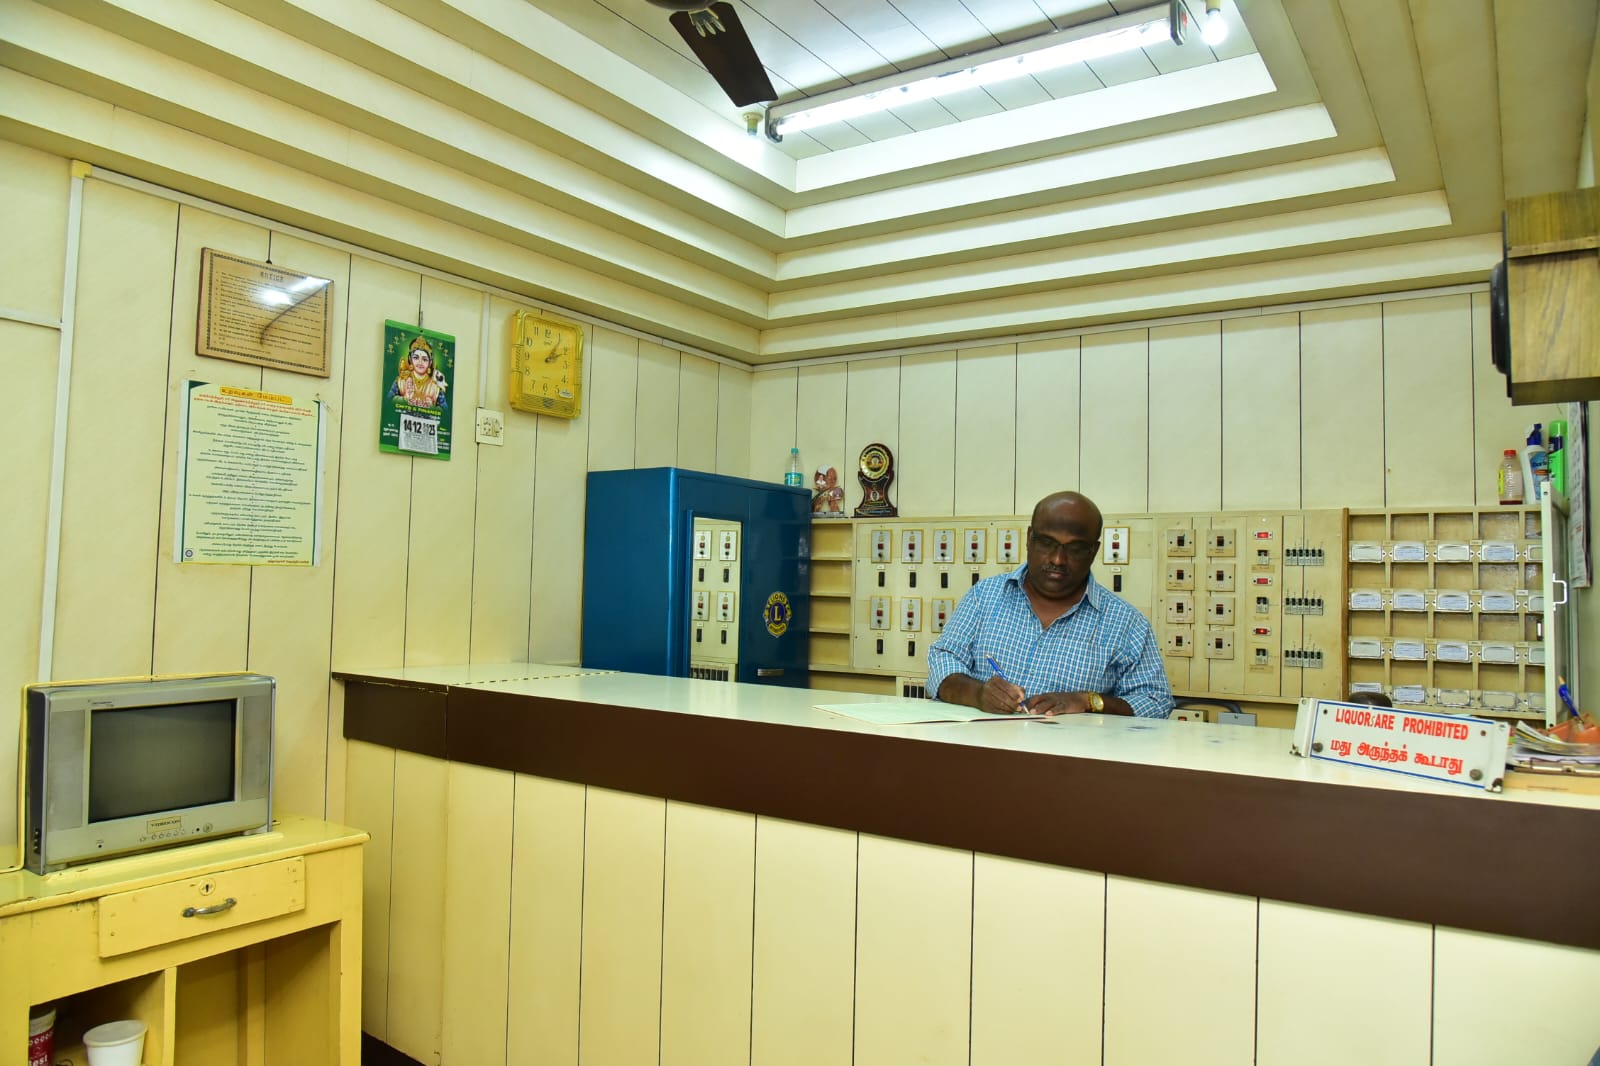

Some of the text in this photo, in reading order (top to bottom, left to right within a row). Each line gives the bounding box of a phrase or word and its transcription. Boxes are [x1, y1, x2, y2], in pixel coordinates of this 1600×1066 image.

[1374, 713, 1396, 731] ARE
[1402, 717, 1469, 741] PROHIBITED
[1330, 739, 1464, 775] மது அருந்தக் கூடாது
